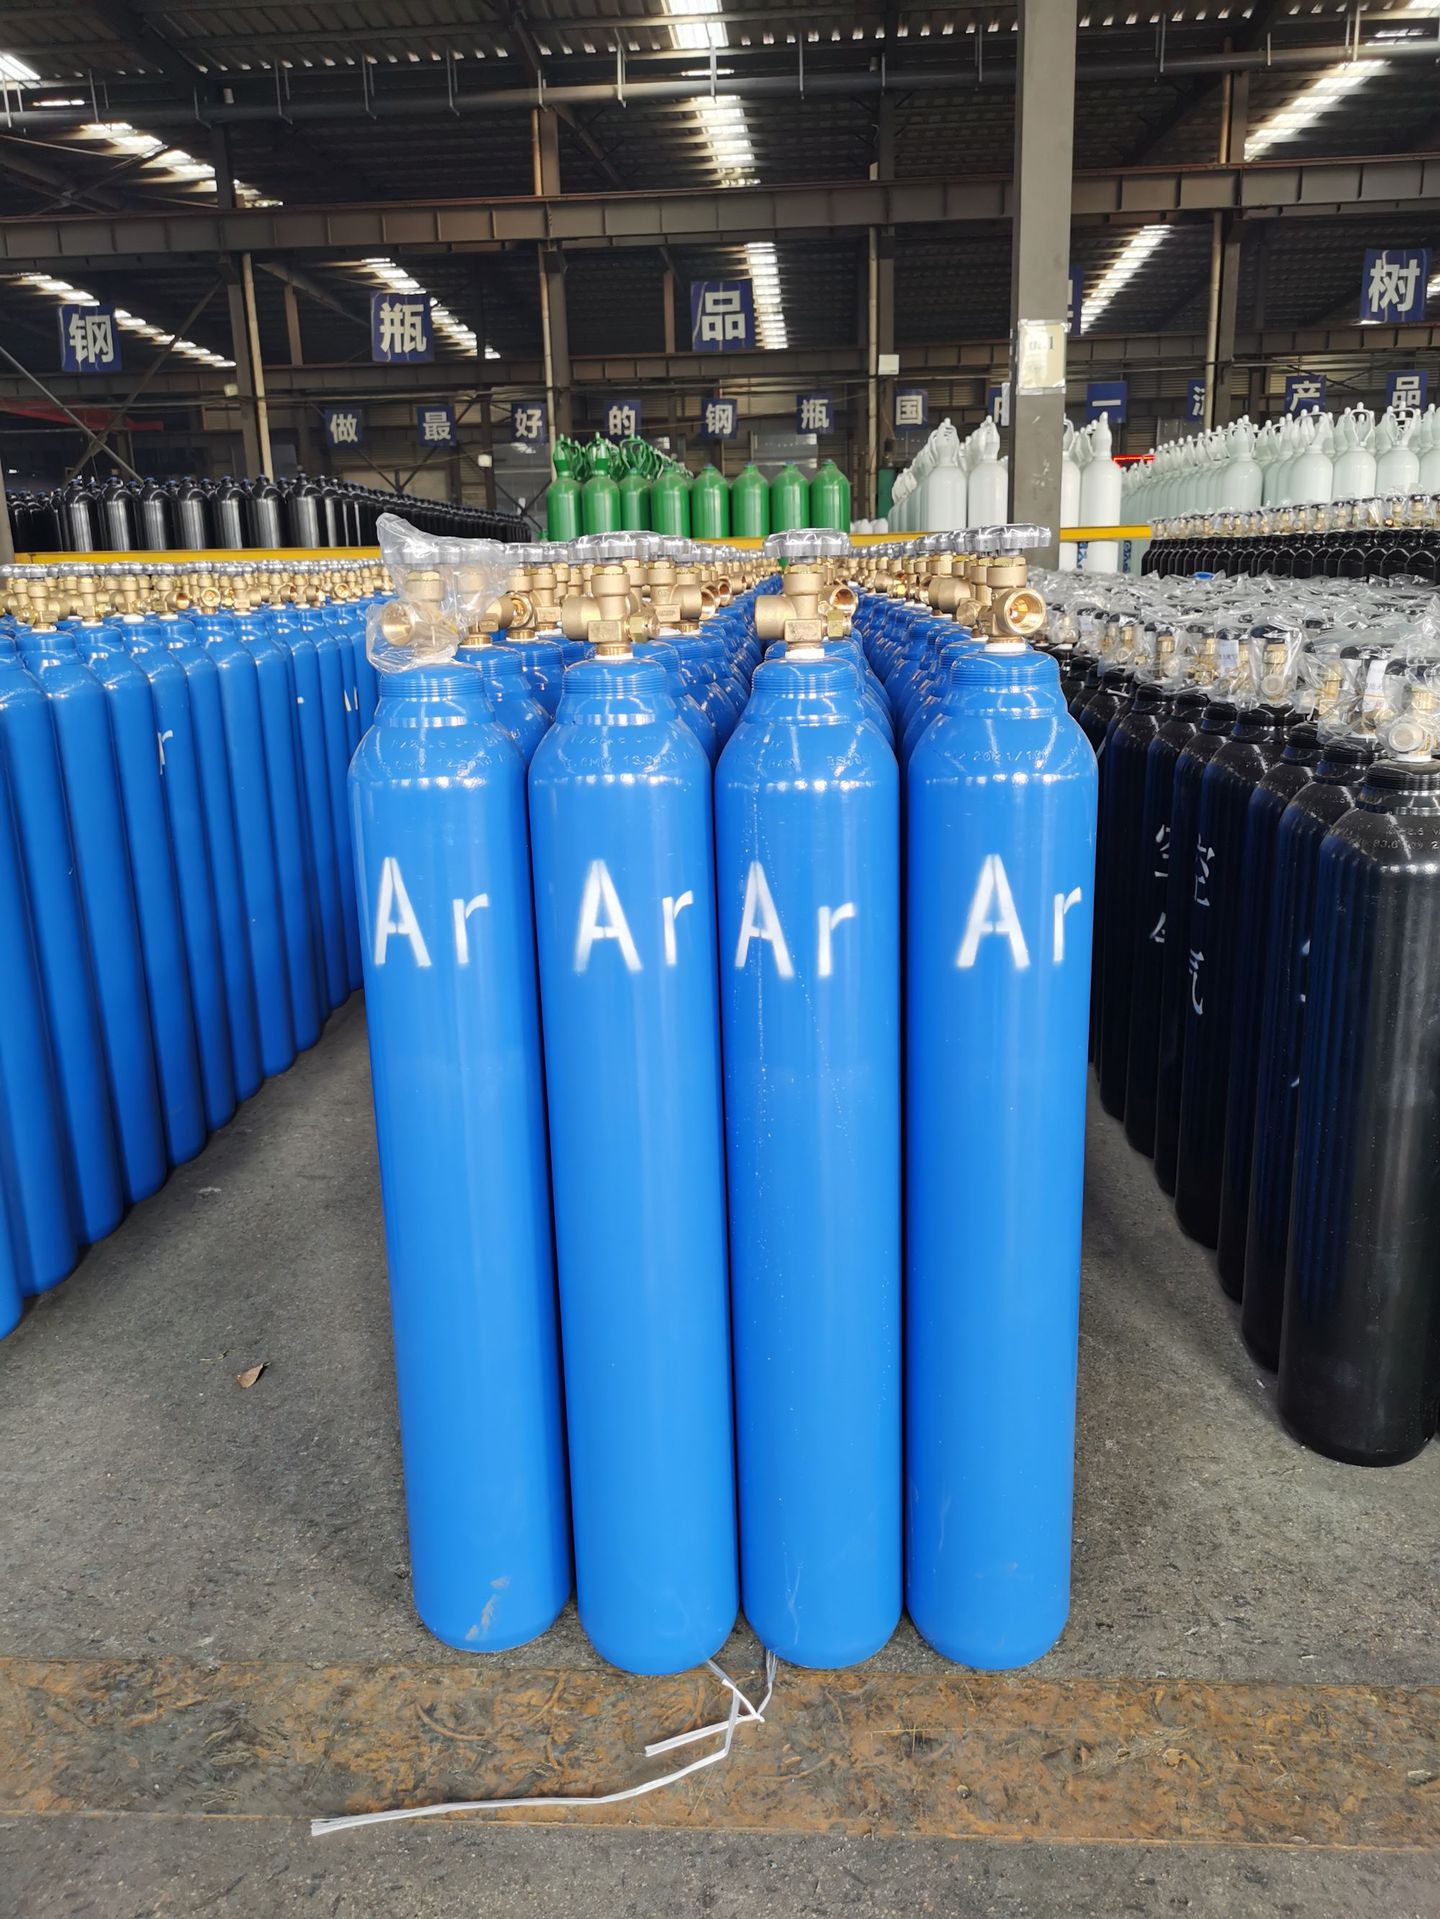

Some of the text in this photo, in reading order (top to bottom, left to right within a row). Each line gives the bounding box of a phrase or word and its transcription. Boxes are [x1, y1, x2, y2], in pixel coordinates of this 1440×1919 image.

[1368, 259, 1420, 313] 树
[380, 303, 427, 354] 瓶
[702, 290, 746, 341] 品
[69, 313, 113, 364] 钢
[1289, 381, 1321, 412] 产
[1392, 376, 1421, 407] 品
[515, 408, 543, 439] 好
[608, 405, 636, 435] 的
[705, 403, 733, 434] 钢
[801, 399, 830, 429] 瓶
[895, 395, 923, 425] 国
[330, 413, 358, 444] 做
[423, 411, 451, 441] 最
[374, 857, 490, 968] Ar
[574, 859, 694, 973] Ar
[735, 861, 856, 977] Ar
[956, 854, 1083, 968] Ar
